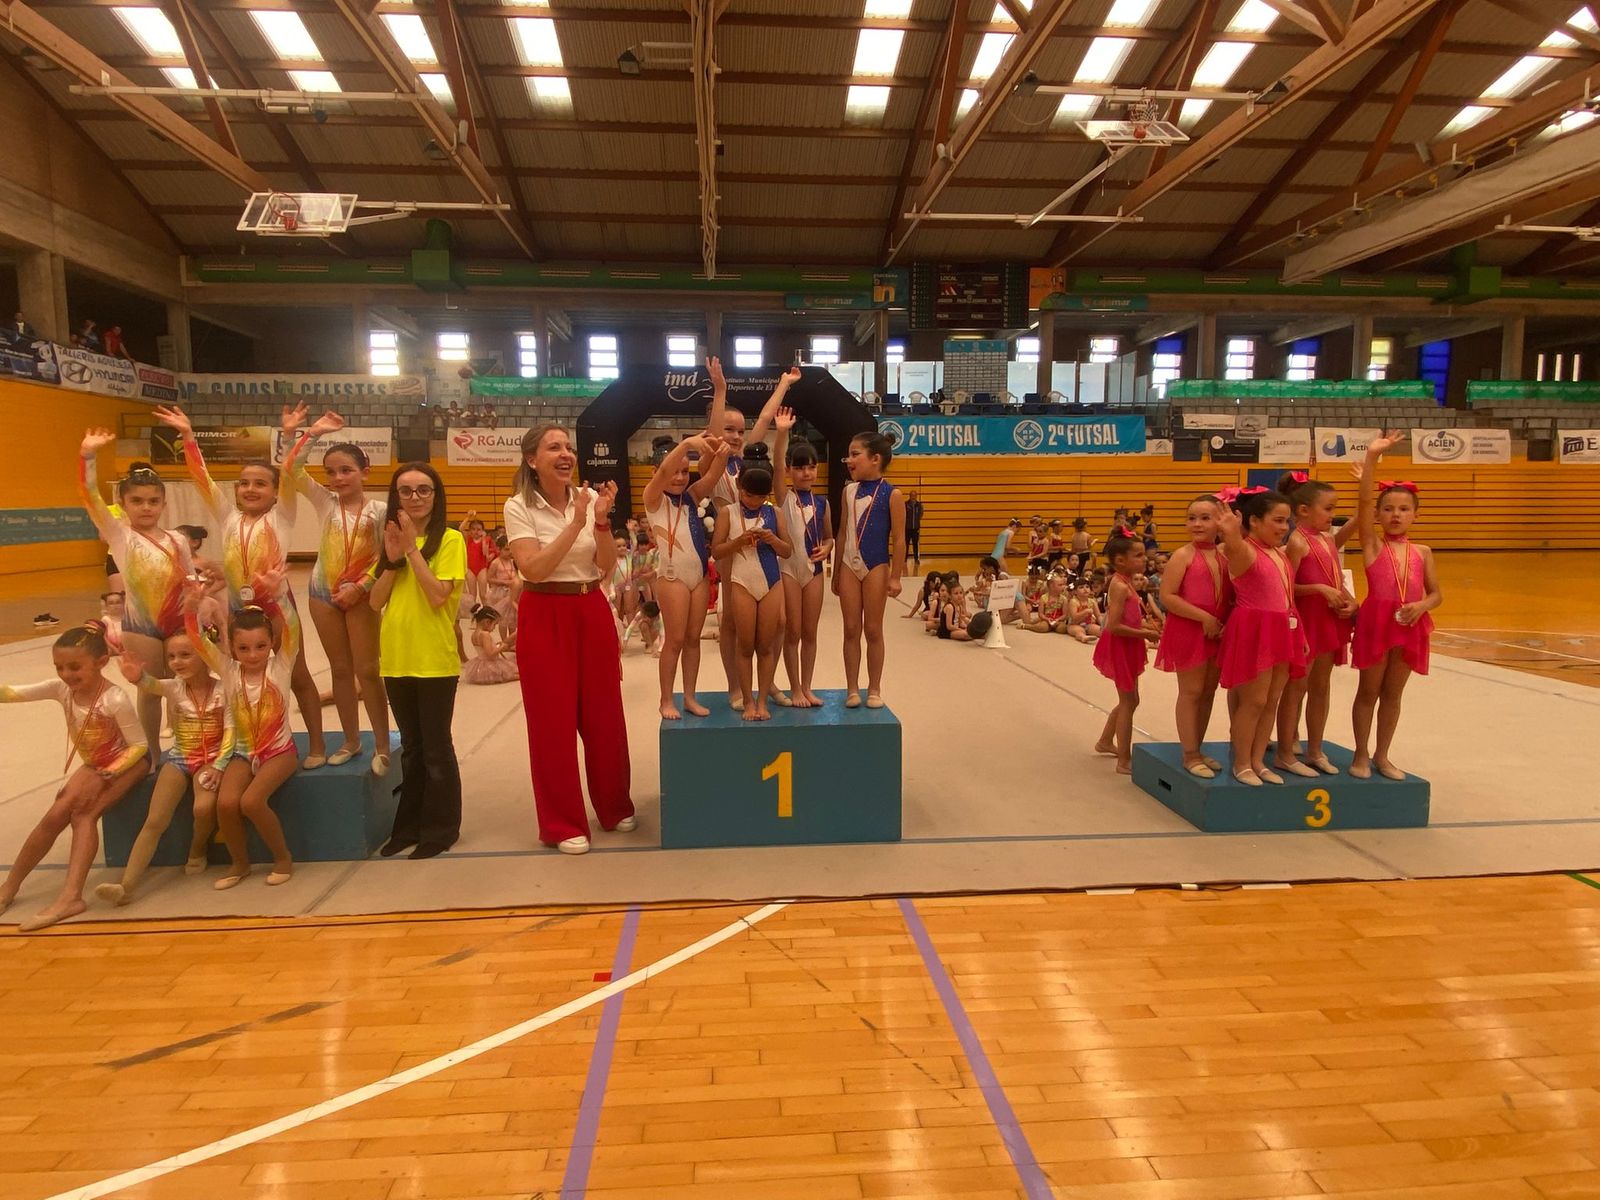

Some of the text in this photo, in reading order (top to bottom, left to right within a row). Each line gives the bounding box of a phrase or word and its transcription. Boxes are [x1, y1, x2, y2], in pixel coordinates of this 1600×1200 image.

[664, 371, 699, 387] imd
[748, 377, 780, 385] Municipal
[727, 384, 755, 392] Deportes
[477, 435, 522, 446] RGAud
[928, 424, 981, 447] FUTSAL
[1067, 423, 1120, 446] FUTSAL
[586, 457, 619, 467] cajamar
[762, 751, 793, 818] 1
[1305, 788, 1332, 828] 3
